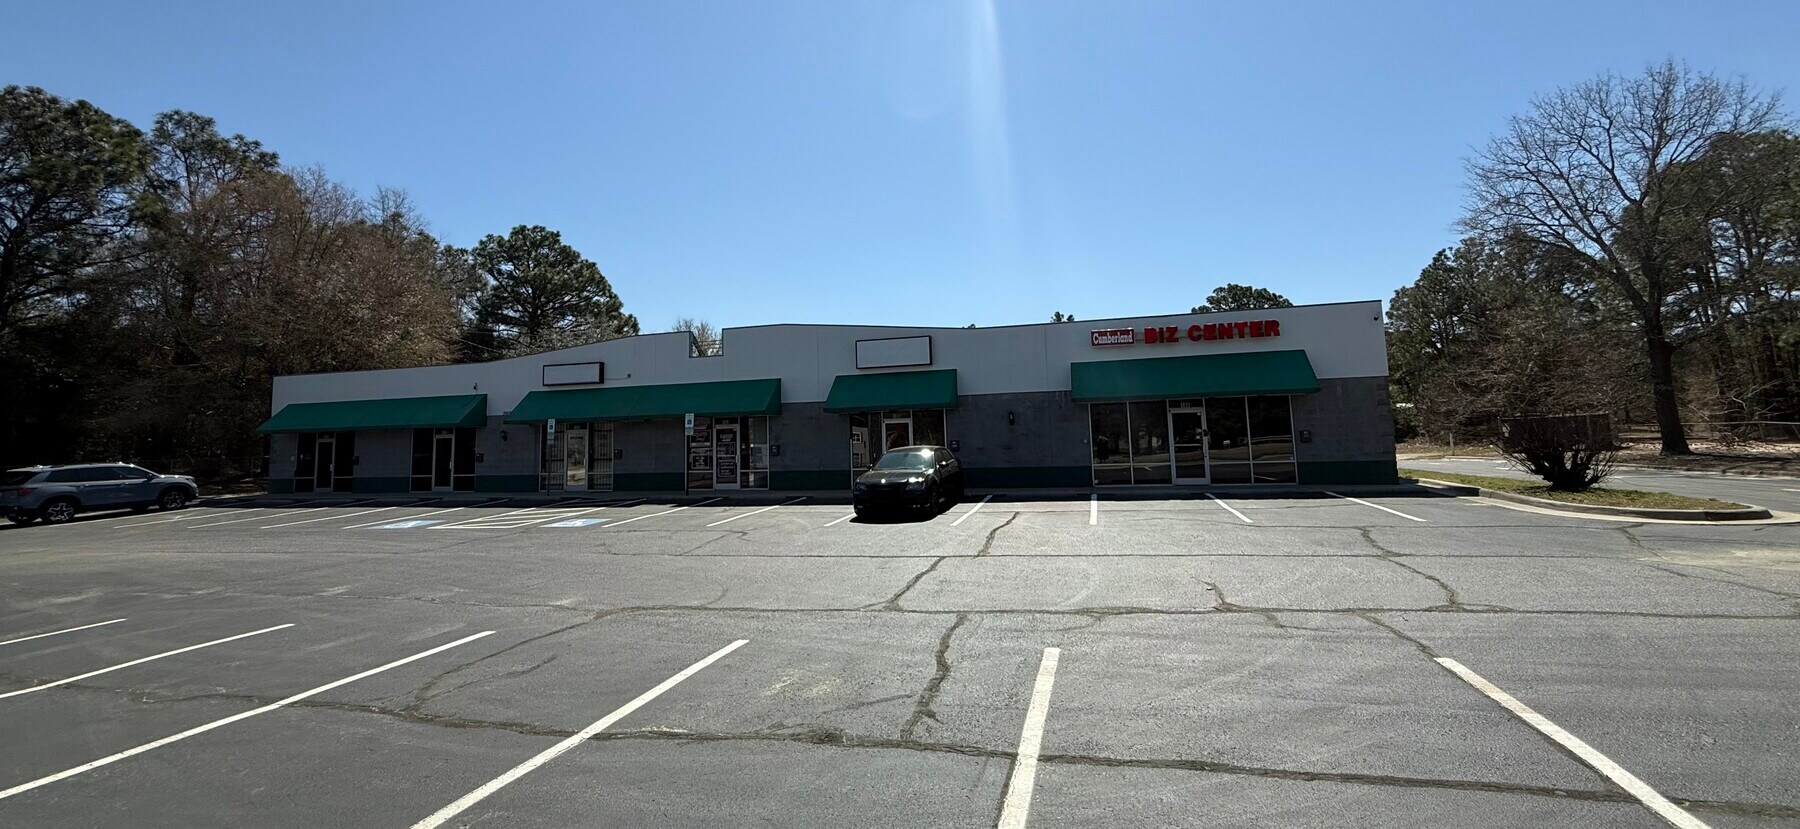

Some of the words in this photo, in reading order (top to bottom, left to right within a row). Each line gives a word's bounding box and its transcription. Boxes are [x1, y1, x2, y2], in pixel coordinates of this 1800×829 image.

[1093, 332, 1133, 344] Cumberland
[1144, 326, 1179, 344] BIZ
[1188, 320, 1280, 341] CENTER
